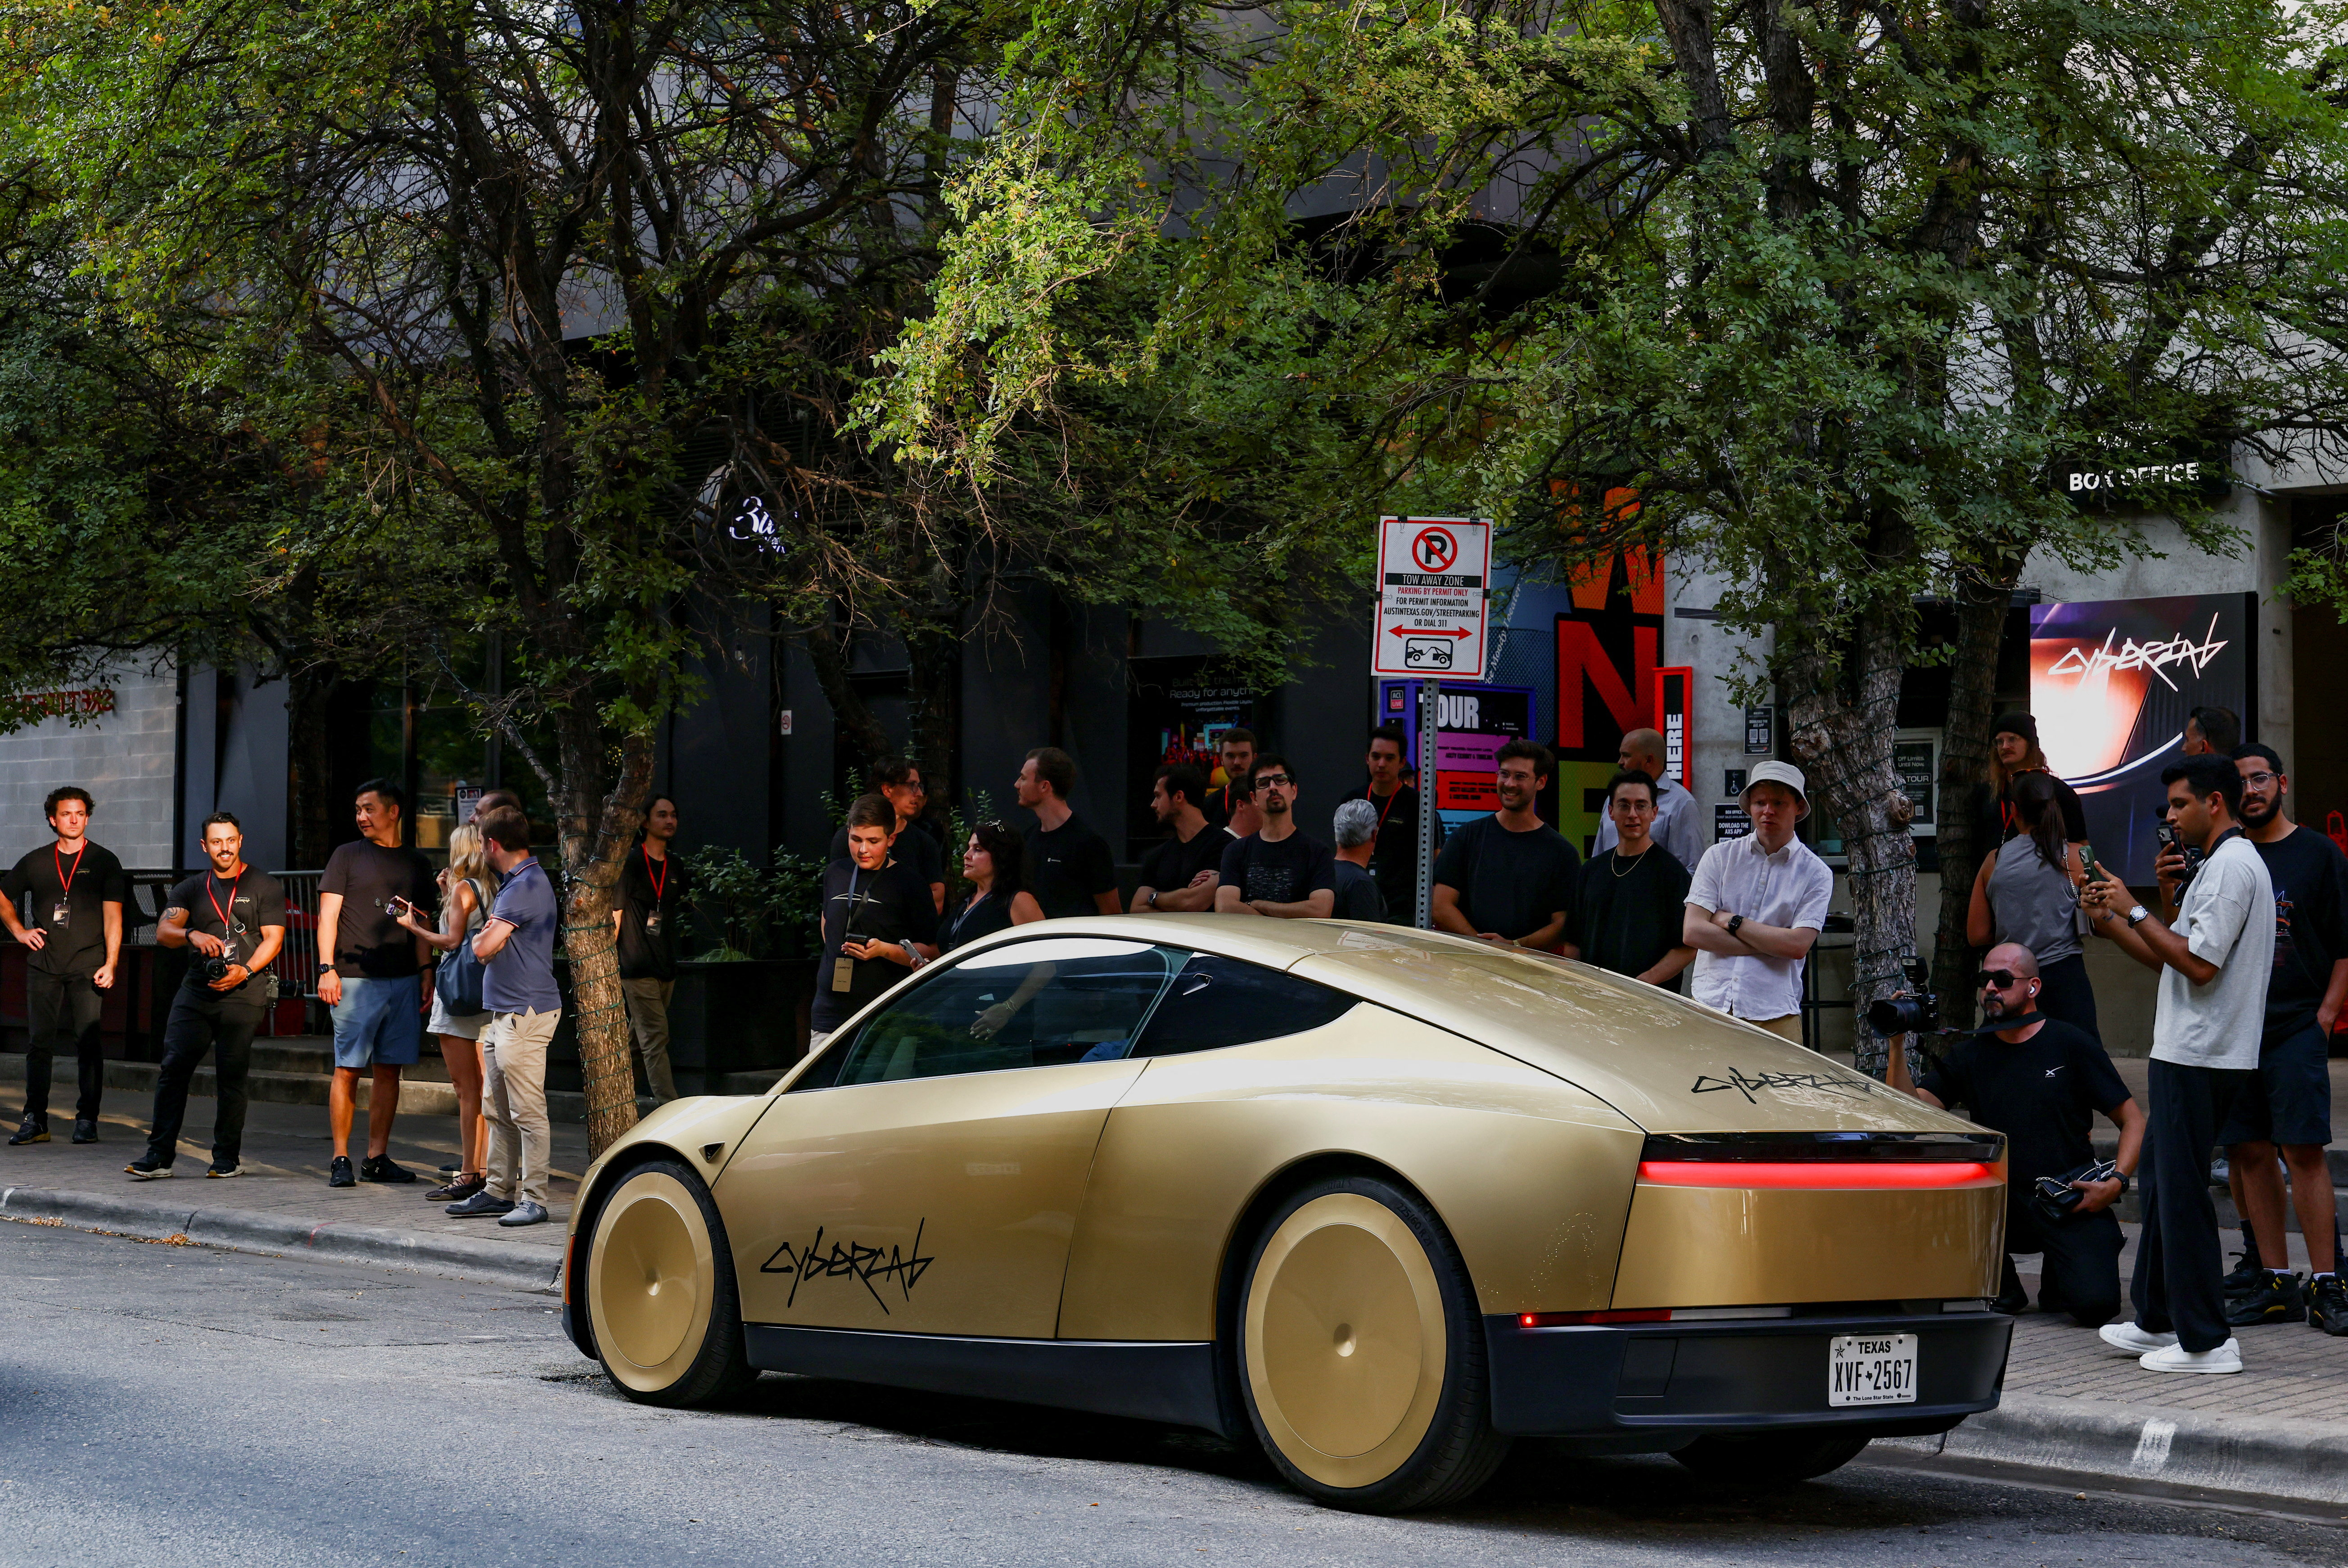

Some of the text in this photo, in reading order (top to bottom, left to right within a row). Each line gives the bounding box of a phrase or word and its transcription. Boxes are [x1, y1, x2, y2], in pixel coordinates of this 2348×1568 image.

[1403, 574, 1464, 586] TOW AWAY ZONE
[1398, 587, 1422, 595] PARKING
[1432, 588, 1452, 596] PERMIT
[1409, 598, 1428, 606] PERMIT
[1430, 599, 1468, 607] INFORMATION
[1384, 607, 1479, 618] AUSTINTEXAS.GOV/STREETPARKING
[1170, 689, 1200, 699] Ready
[1203, 688, 1217, 696] for
[1666, 714, 1683, 779] HERE
[1397, 1202, 1422, 1230] 225/60
[1858, 1341, 1891, 1354] TEXAS
[1835, 1359, 1911, 1392] XVF 2567
